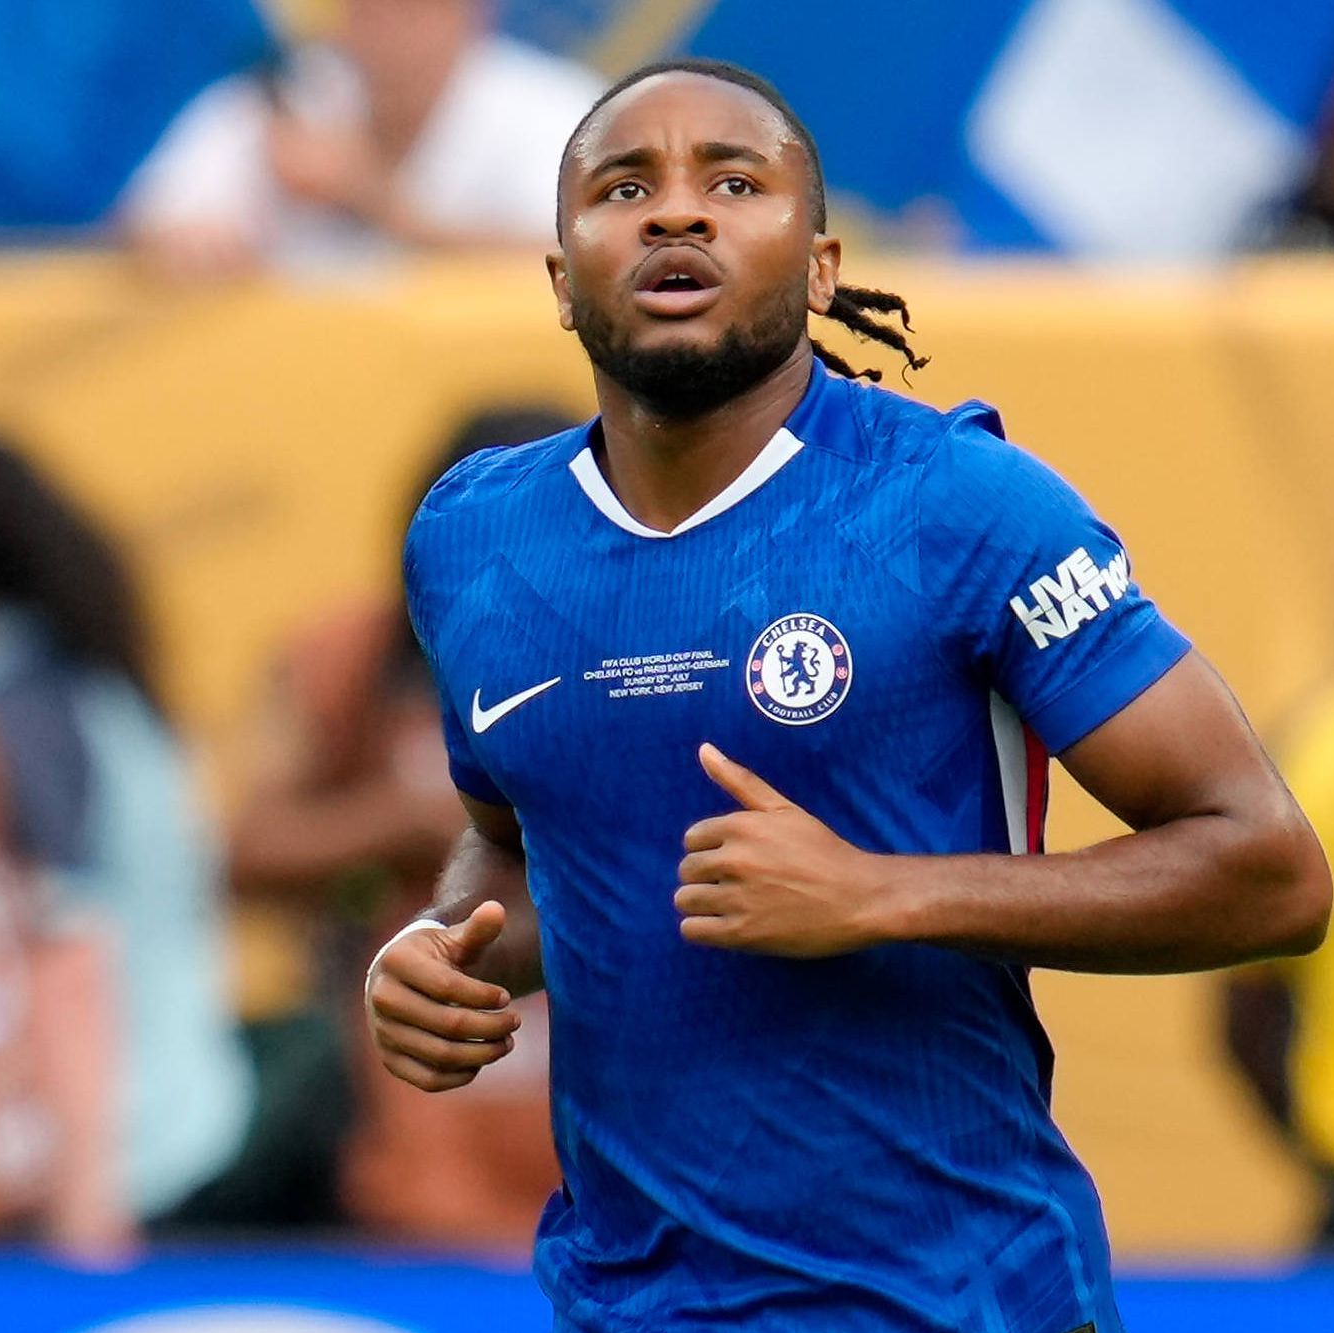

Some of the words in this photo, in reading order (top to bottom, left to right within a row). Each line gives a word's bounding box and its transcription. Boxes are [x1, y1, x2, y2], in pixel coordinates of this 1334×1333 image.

[1009, 546, 1100, 624] LIVE
[762, 618, 826, 647] CHELSEA
[602, 659, 618, 668] FIFA
[619, 657, 641, 667] CLUB
[642, 654, 672, 665] WORLD
[673, 652, 691, 661] CUP
[691, 650, 714, 660] FINAL
[583, 670, 622, 680] CHELSEA
[643, 664, 667, 674] PARIS
[623, 676, 655, 687] SUNDAY
[671, 673, 690, 682] JULY
[609, 689, 629, 698] NEW
[654, 684, 673, 694] NEW
[673, 681, 704, 692] JERSEY
[767, 703, 814, 719] FOOTBALL
[817, 691, 838, 711] CLUB
